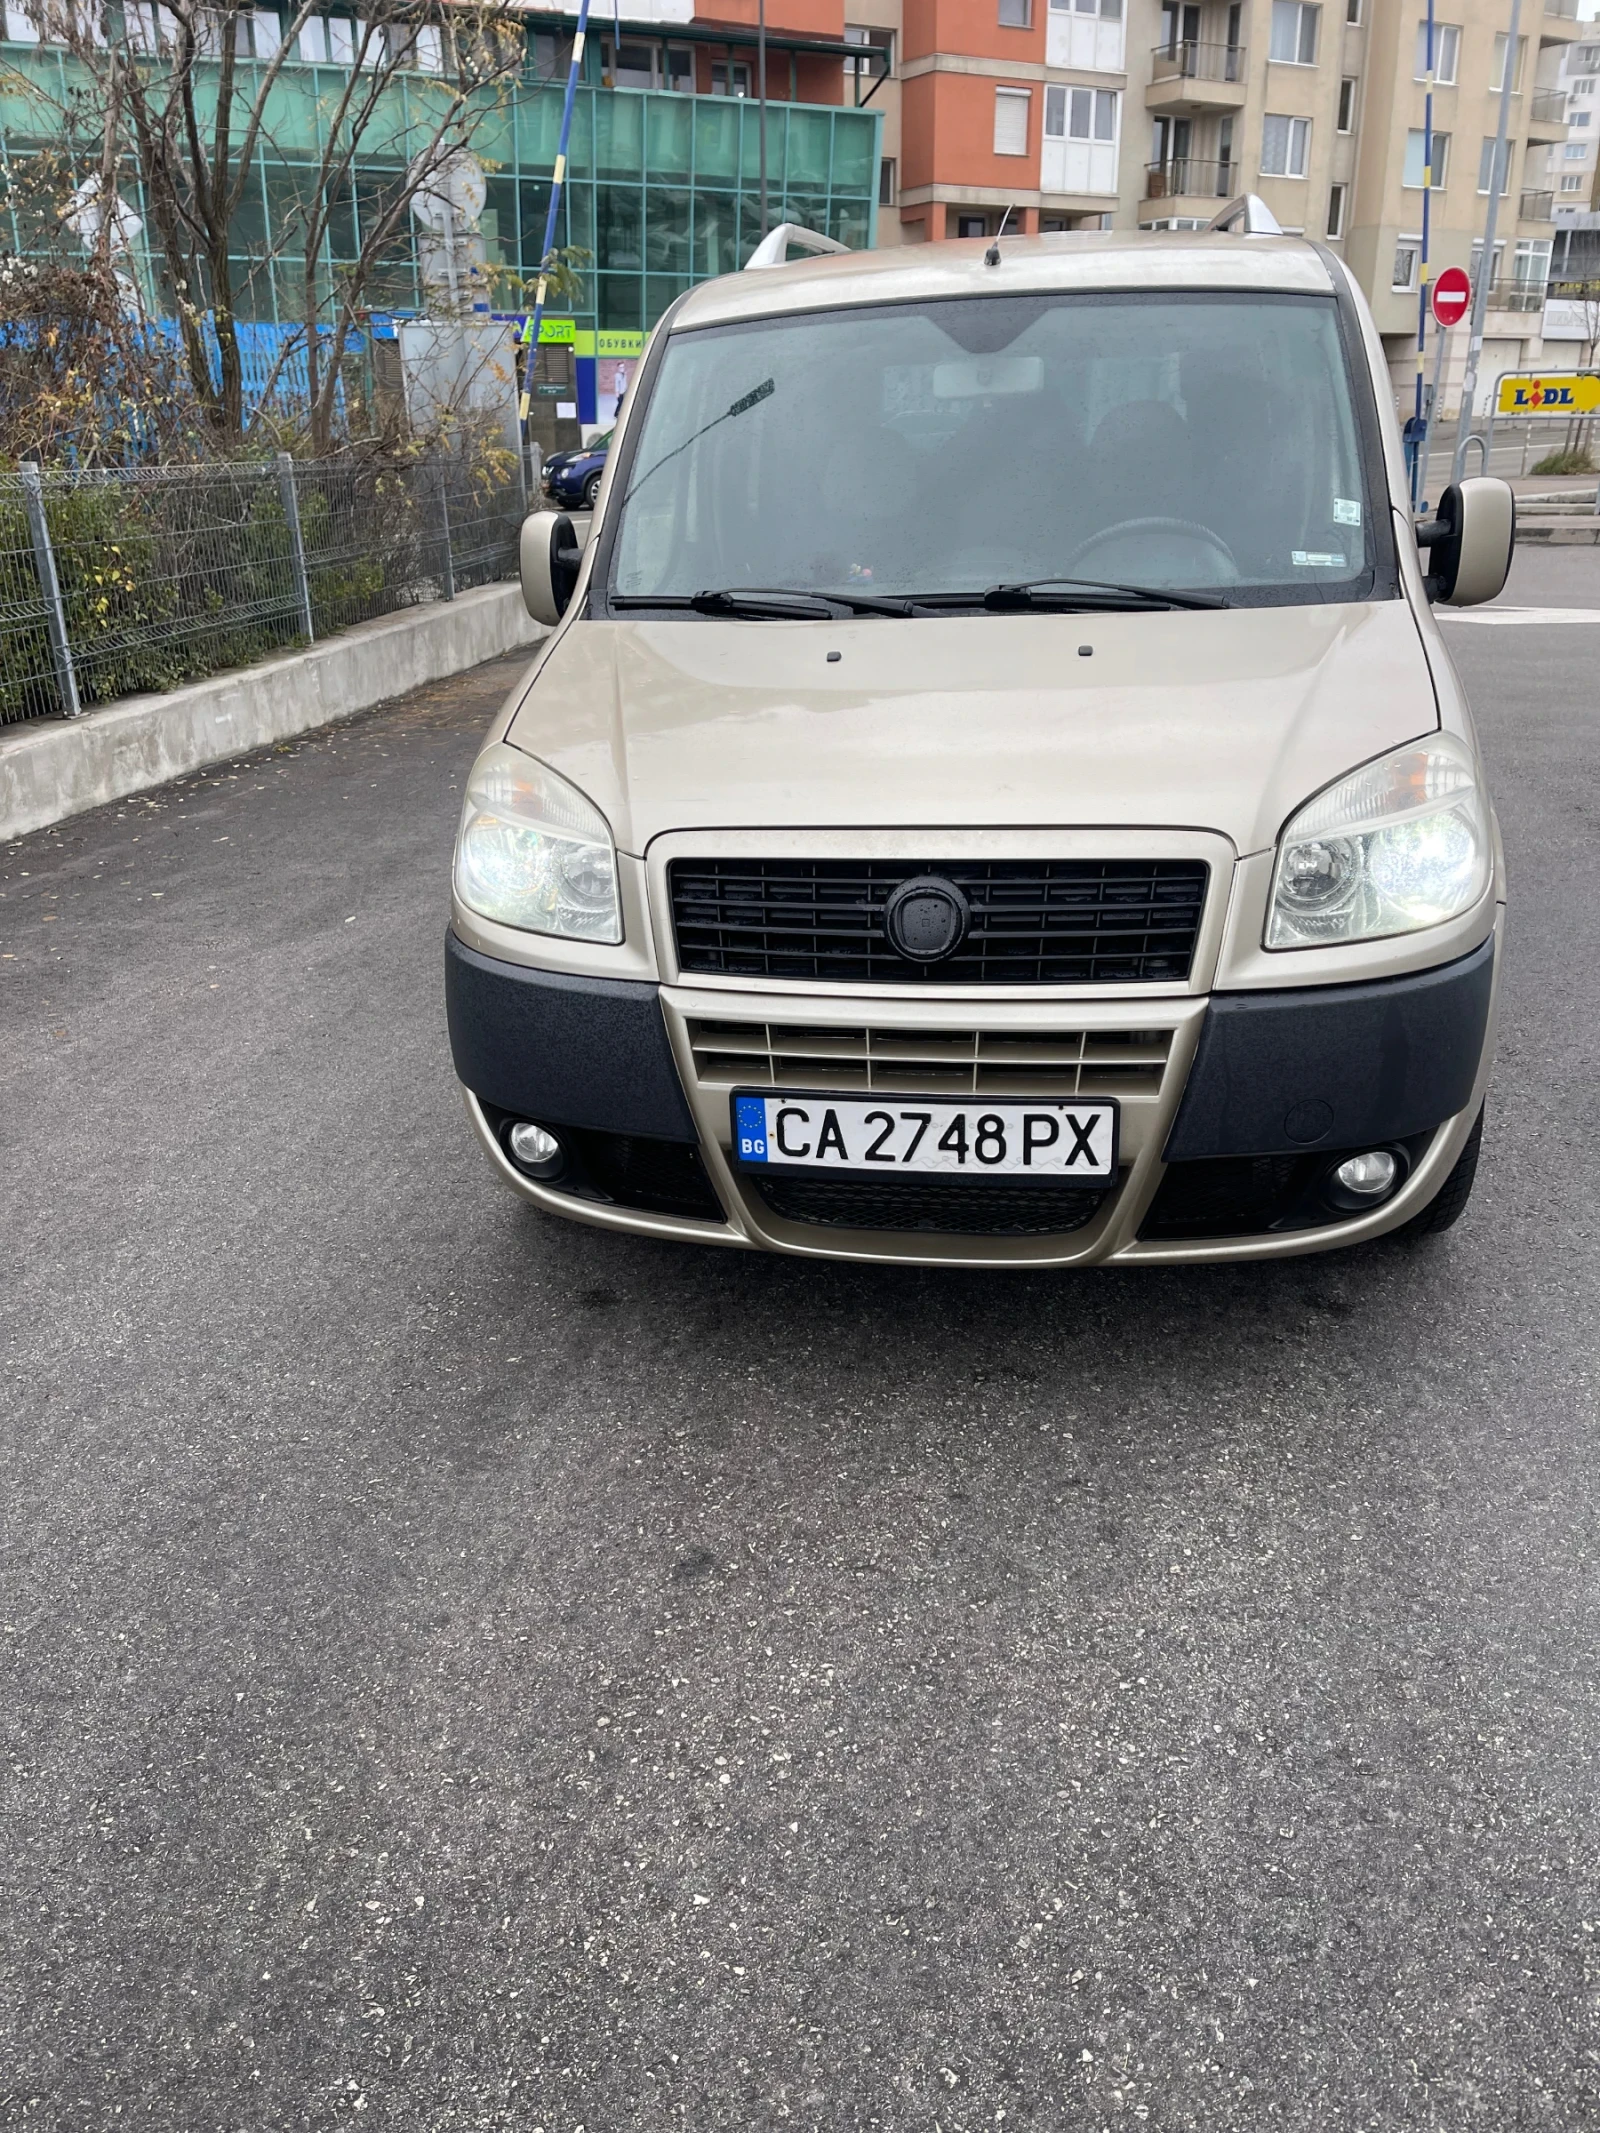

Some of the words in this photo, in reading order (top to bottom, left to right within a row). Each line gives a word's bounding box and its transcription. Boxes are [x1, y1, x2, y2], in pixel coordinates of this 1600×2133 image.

[599, 338, 643, 349] ОБУВКИ
[775, 1107, 849, 1161] CA
[864, 1110, 1008, 1165] 2748
[1022, 1113, 1102, 1167] PX
[741, 1138, 766, 1155] BG
